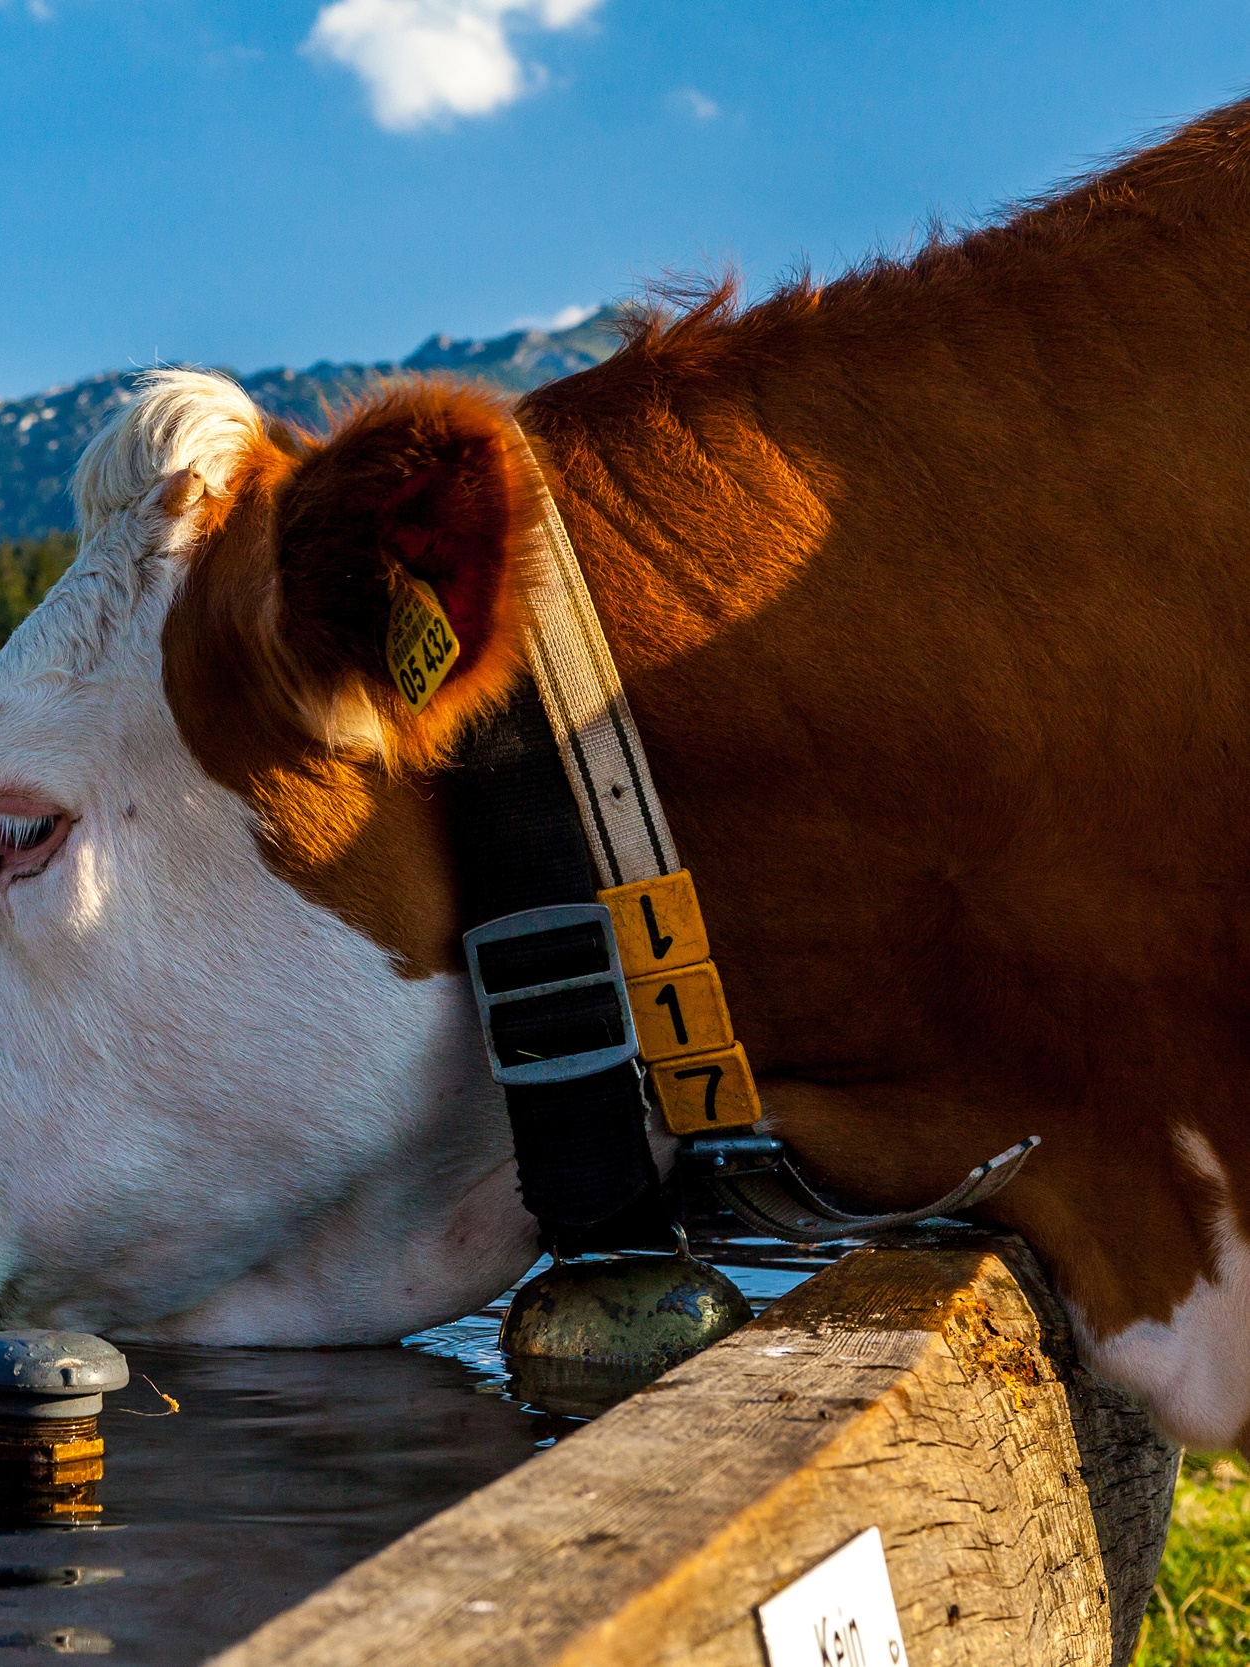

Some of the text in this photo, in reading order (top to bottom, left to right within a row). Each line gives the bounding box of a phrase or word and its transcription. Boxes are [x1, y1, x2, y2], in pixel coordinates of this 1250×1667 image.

[400, 655, 426, 704] 05
[423, 618, 453, 672] 432
[814, 1605, 866, 1667] Kein
